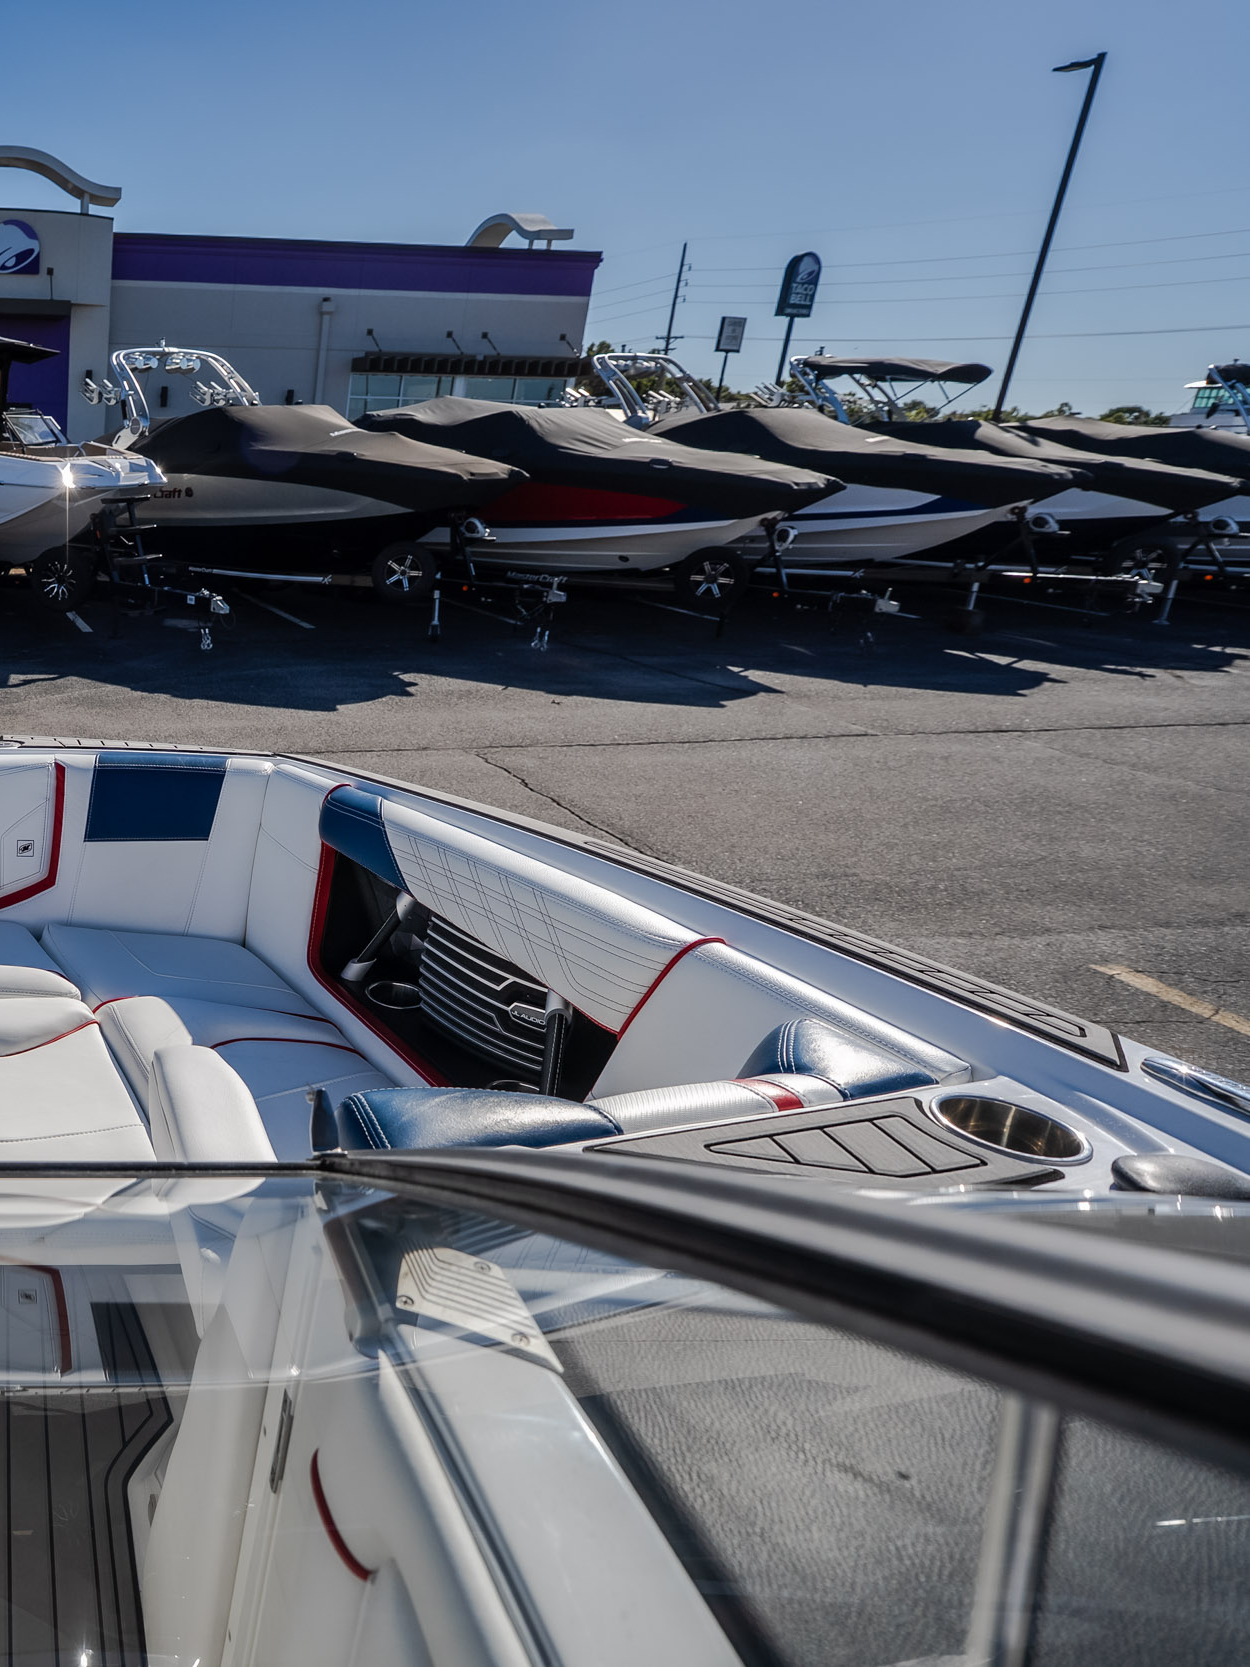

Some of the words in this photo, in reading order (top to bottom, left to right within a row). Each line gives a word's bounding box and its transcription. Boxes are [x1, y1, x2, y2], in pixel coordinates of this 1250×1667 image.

[791, 283, 815, 295] TACO
[789, 293, 812, 305] BELL
[520, 1013, 546, 1026] AUDIO
